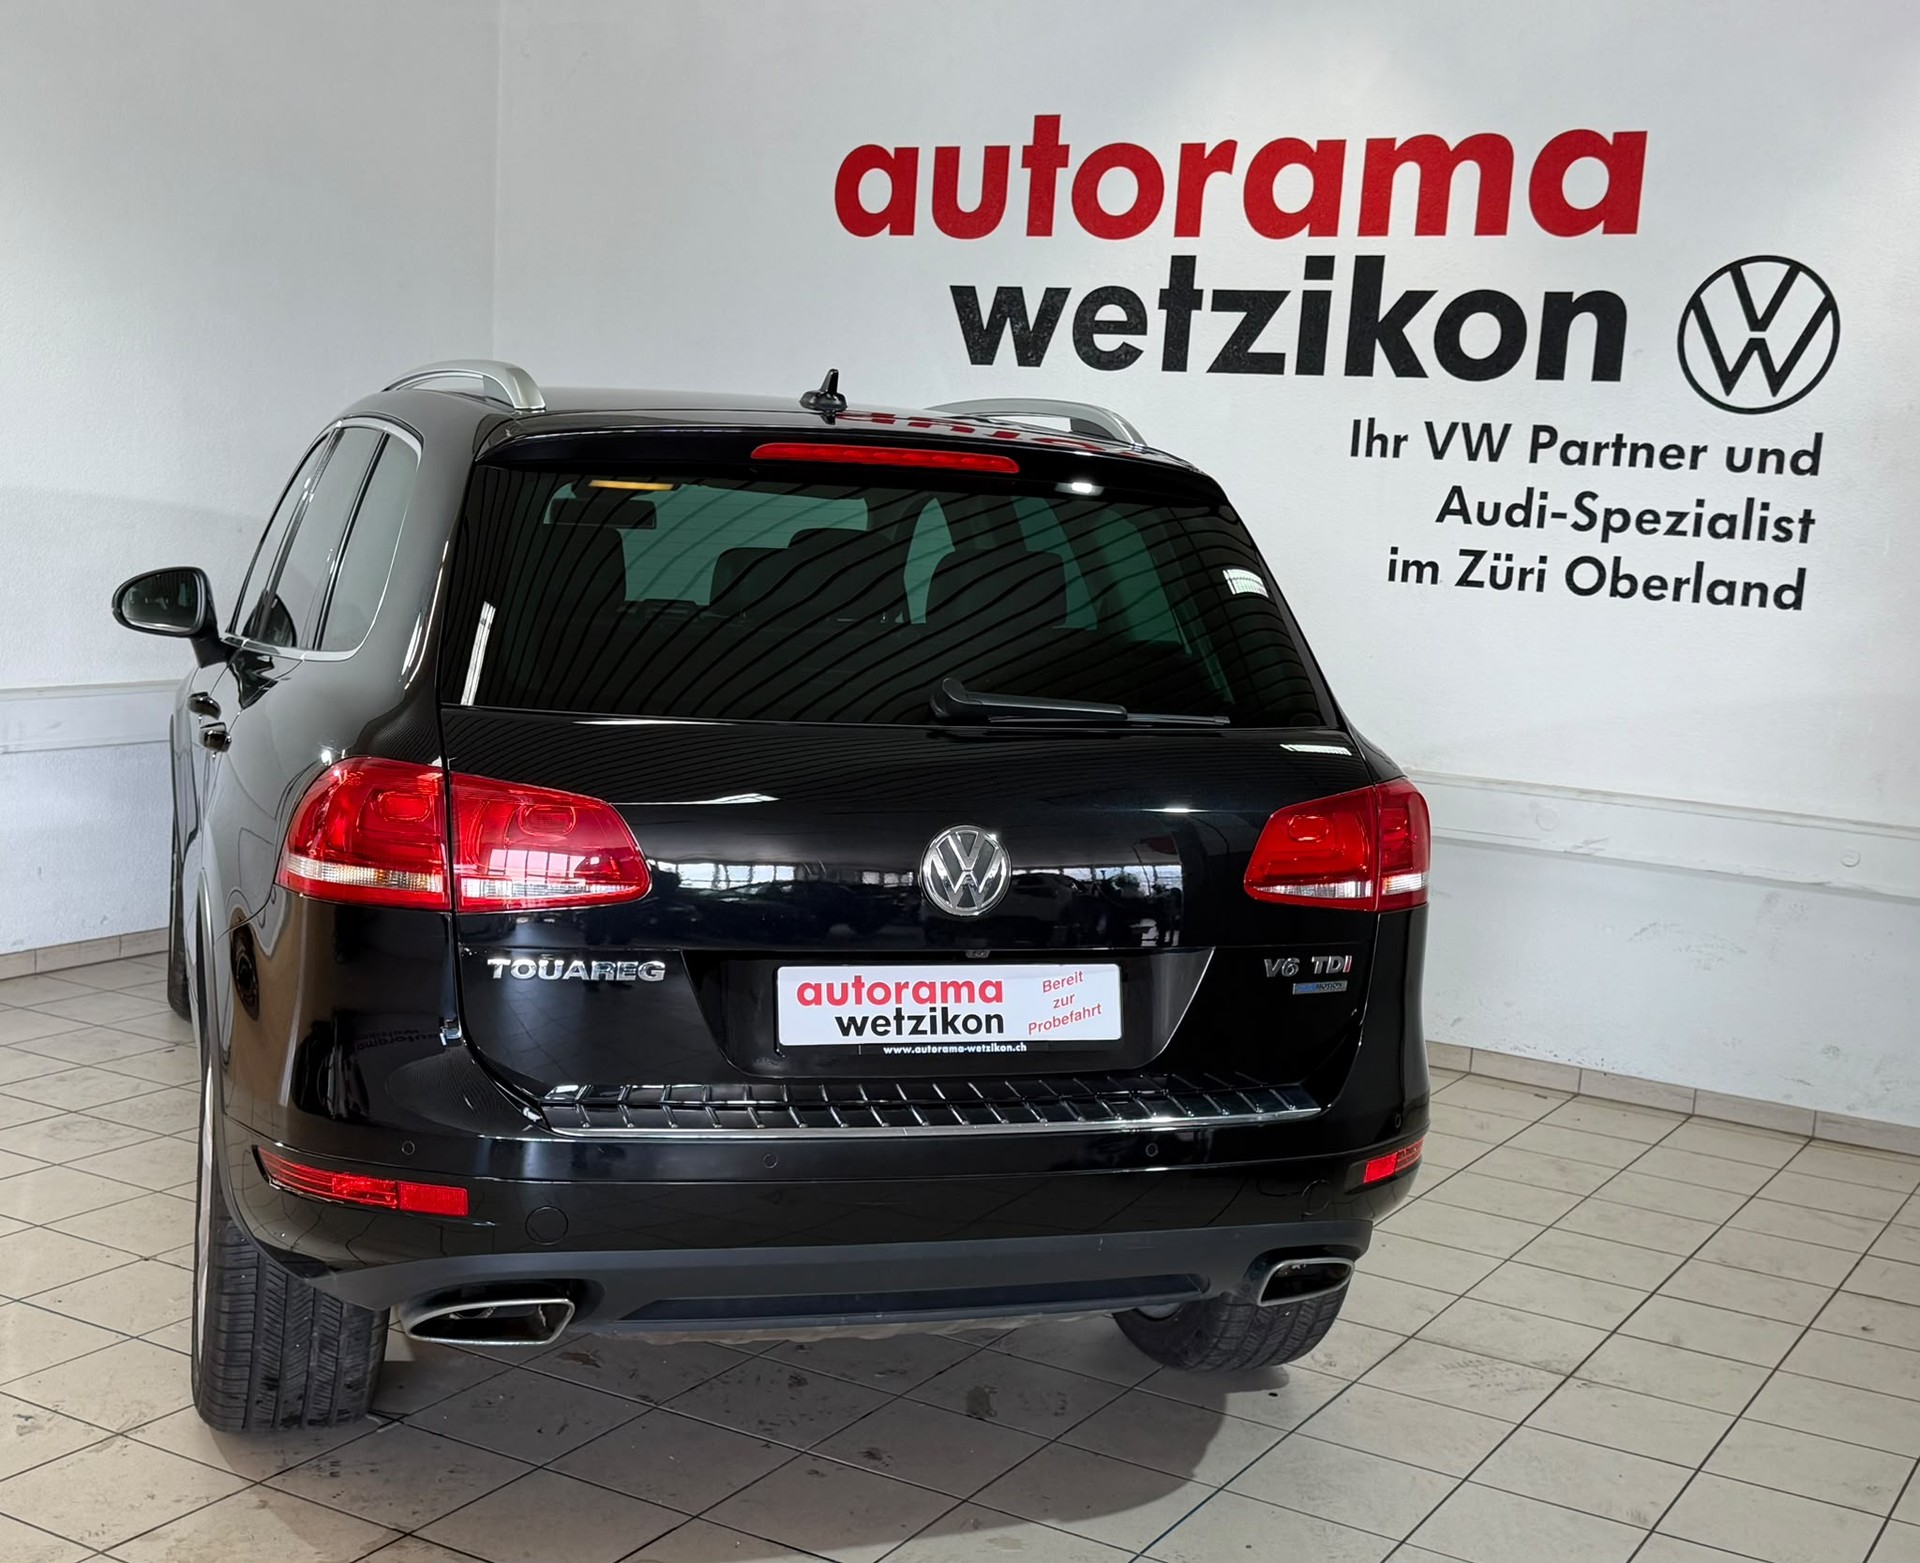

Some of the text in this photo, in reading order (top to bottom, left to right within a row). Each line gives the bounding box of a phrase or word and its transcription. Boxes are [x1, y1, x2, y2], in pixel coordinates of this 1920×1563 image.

[834, 114, 1648, 240] autorama
[949, 254, 1628, 382] wetzikon
[1677, 254, 1841, 415] VW
[1350, 417, 1824, 476] Ihr VW Partner und
[1435, 485, 1816, 546] Audi-Spezialist
[1388, 546, 1807, 611] im Züri Oberland
[921, 824, 1011, 917] VW
[487, 958, 666, 982] TOUAREG
[1042, 970, 1083, 993] Bereit
[1264, 955, 1352, 977] V6 TDI
[796, 975, 1003, 1006] autorama
[1053, 993, 1076, 1009] zur
[834, 1006, 1004, 1037] wetzikon
[1028, 1003, 1102, 1036] Probefahrt
[883, 1042, 1027, 1054] www.autorama-wetzikon.ch
